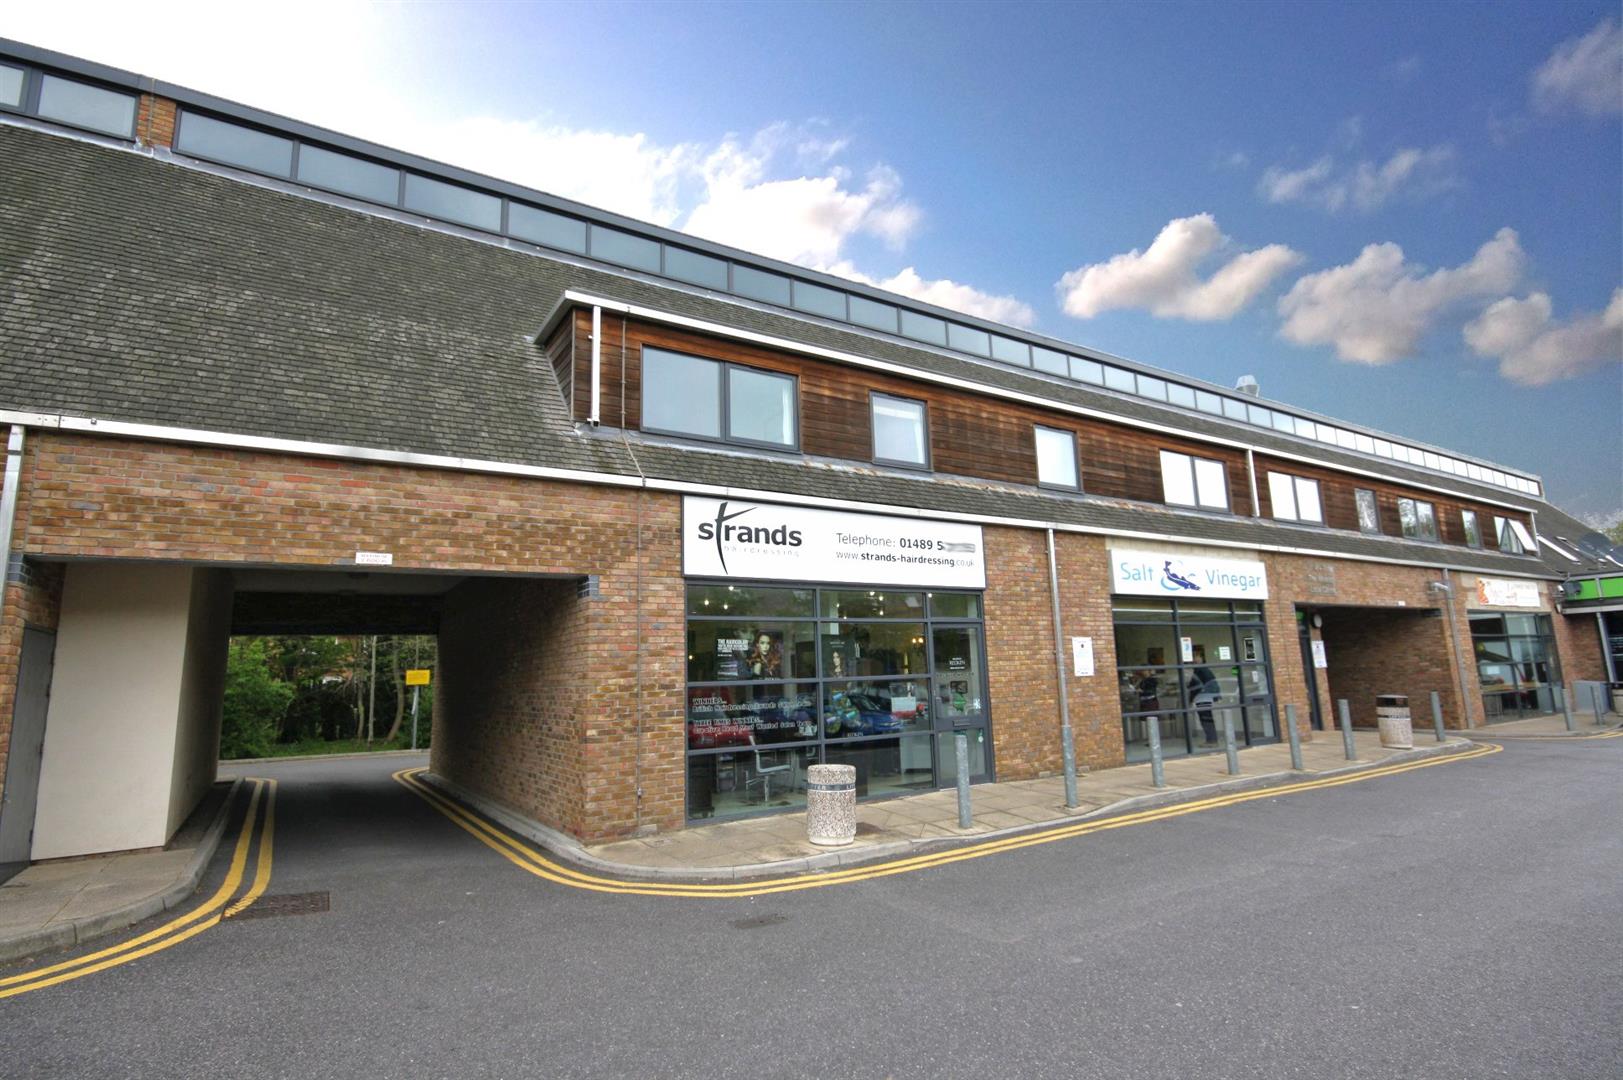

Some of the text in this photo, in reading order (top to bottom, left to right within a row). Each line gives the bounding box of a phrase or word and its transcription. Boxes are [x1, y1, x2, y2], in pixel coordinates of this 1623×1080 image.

[836, 532, 896, 549] Telephone:
[899, 537, 933, 550] 01489
[1119, 561, 1154, 582] Salt
[1205, 568, 1262, 591] Vinegar
